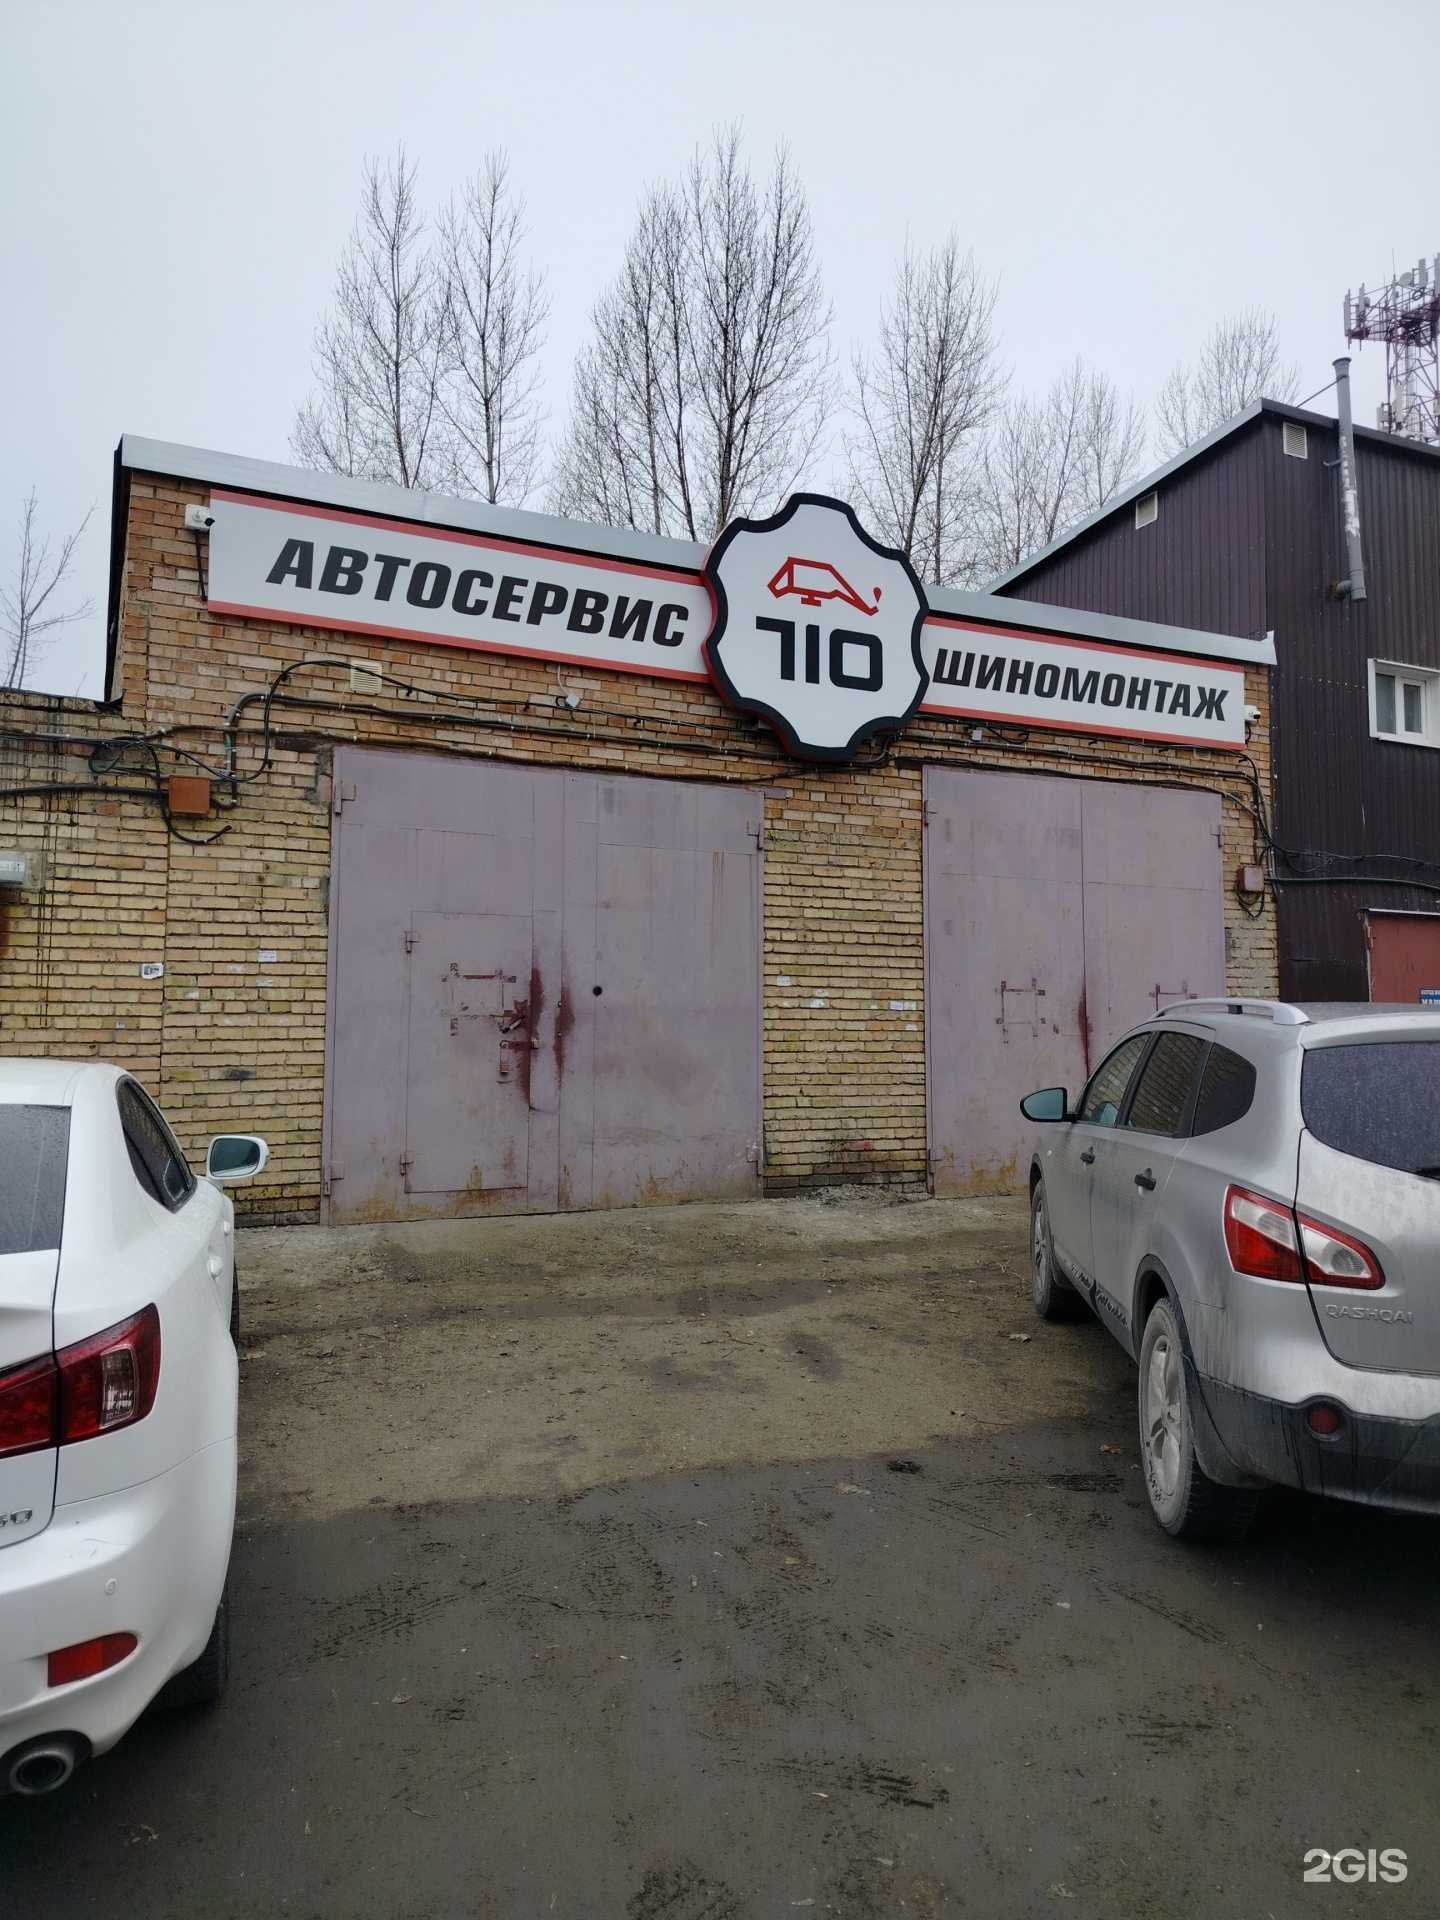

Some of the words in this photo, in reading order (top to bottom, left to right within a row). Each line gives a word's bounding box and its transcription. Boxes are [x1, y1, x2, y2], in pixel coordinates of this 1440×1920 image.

[266, 538, 689, 647] АВТОСЕРВИС
[933, 648, 1229, 722] ШИНОМОНТАЖ
[1326, 1304, 1415, 1325] QASHQAI
